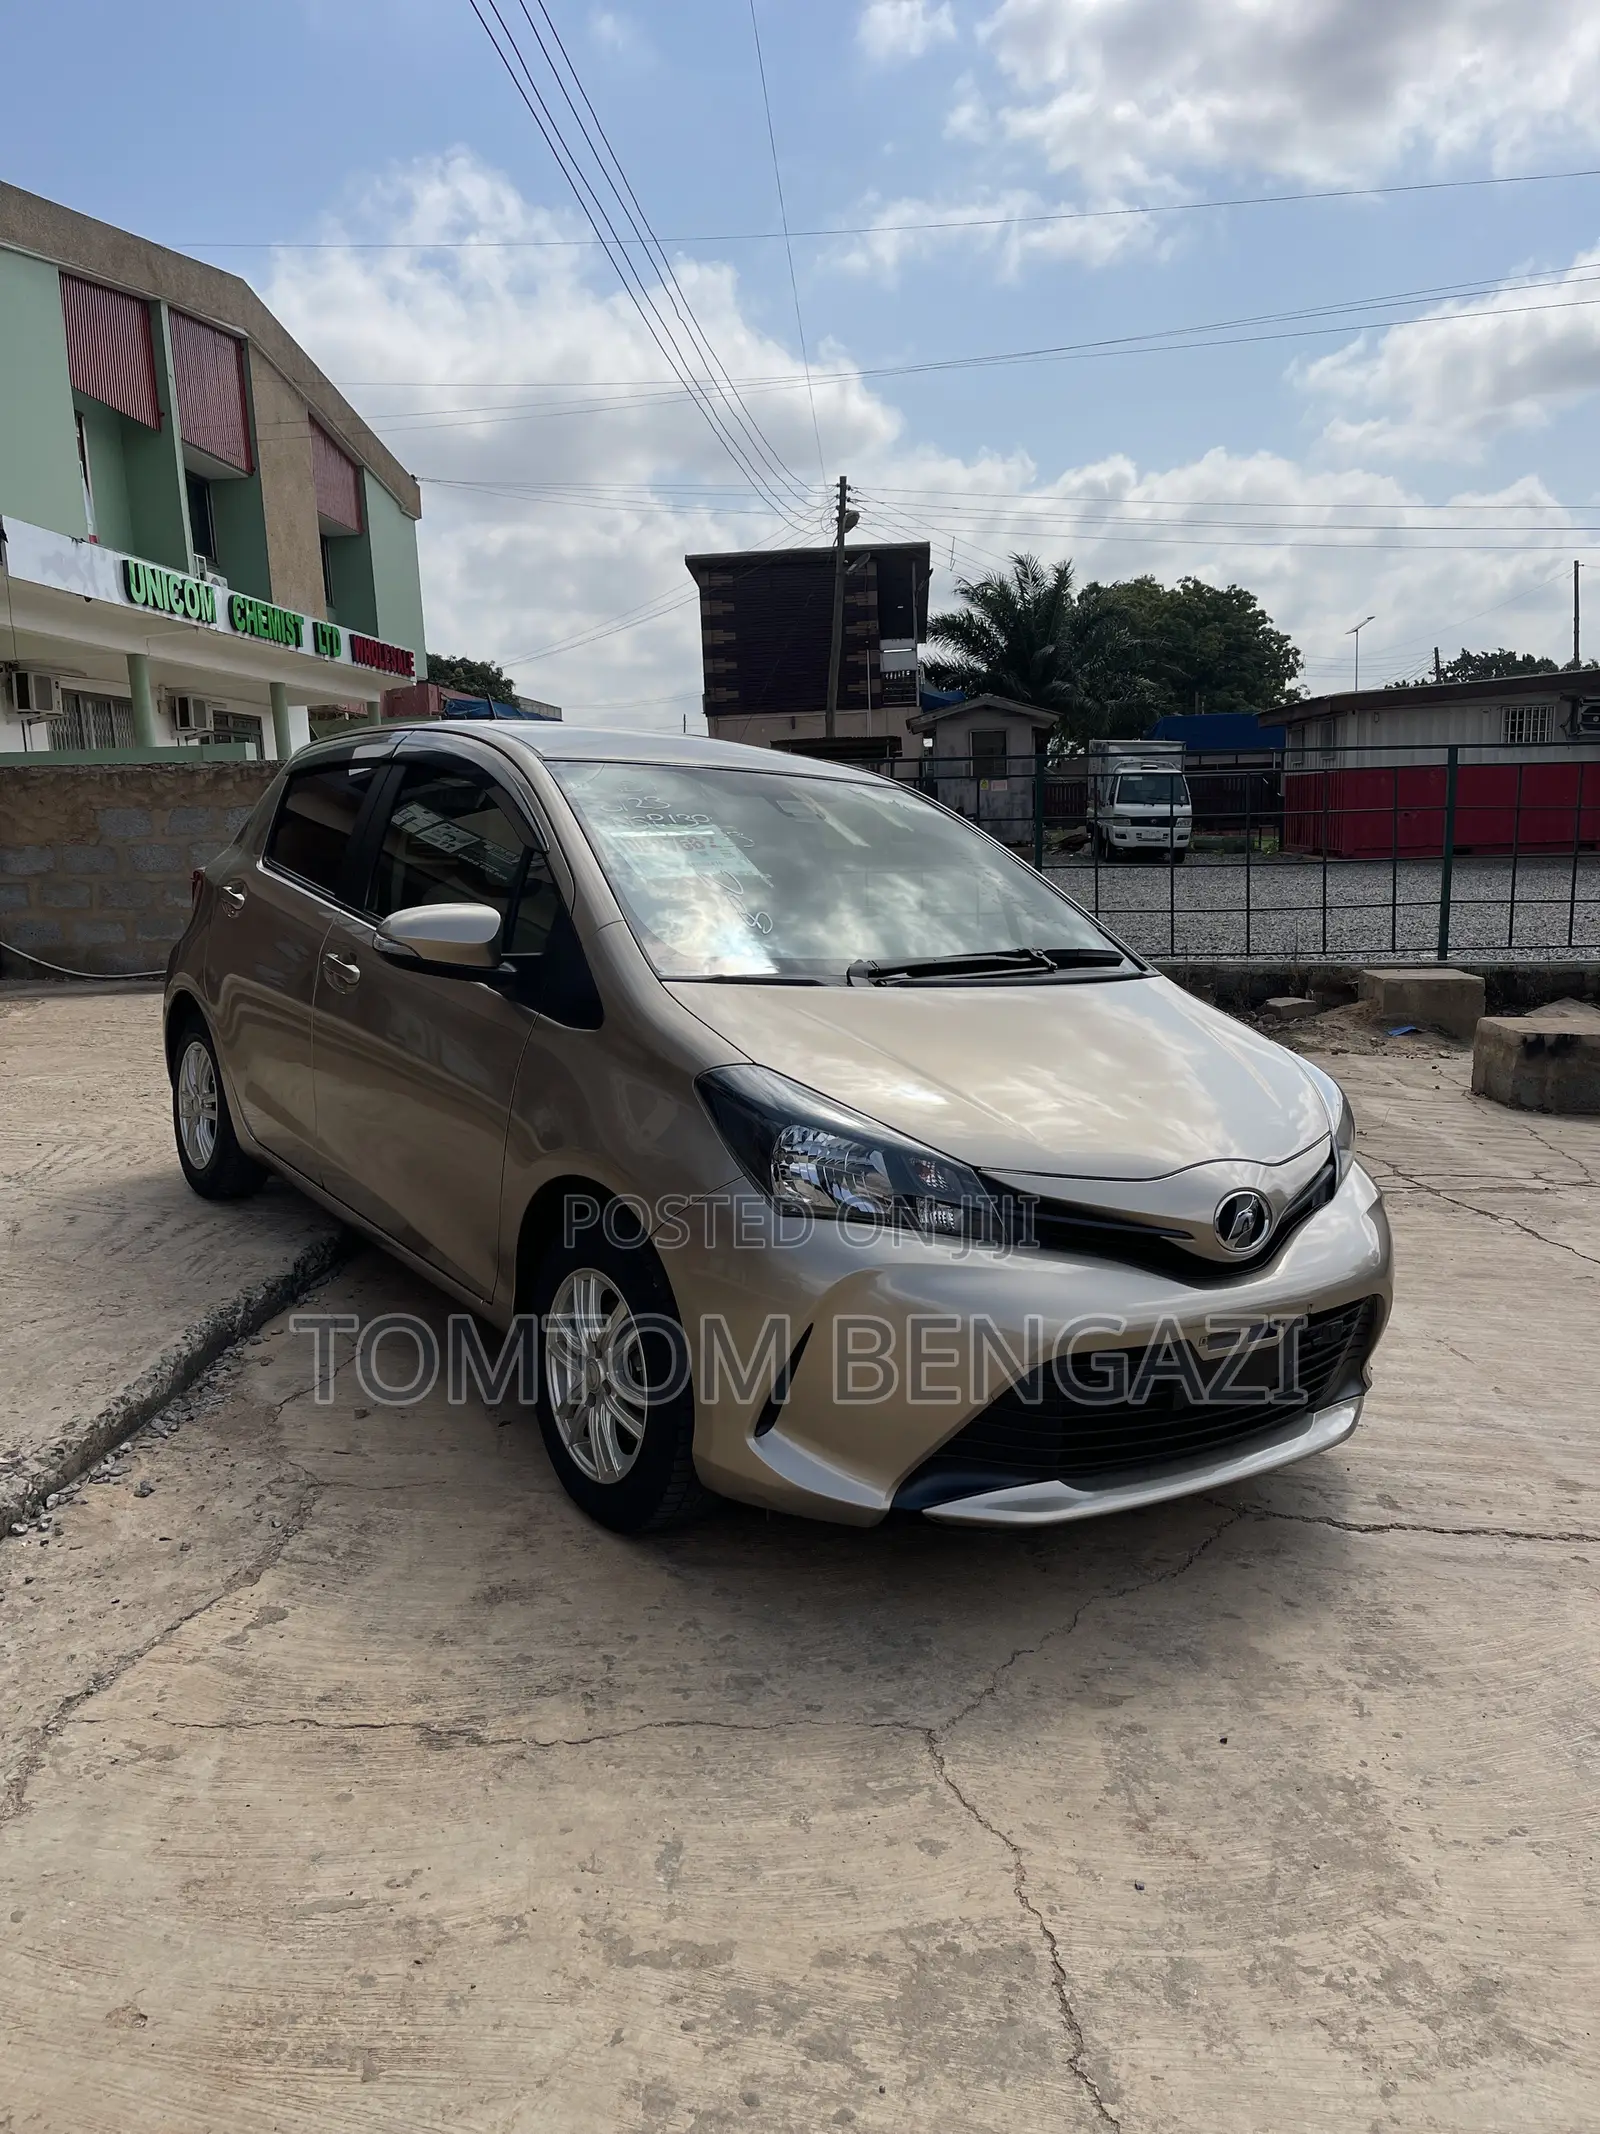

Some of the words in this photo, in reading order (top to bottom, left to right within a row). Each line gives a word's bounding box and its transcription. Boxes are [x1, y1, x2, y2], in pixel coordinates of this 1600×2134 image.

[122, 559, 217, 624] UNICOM
[228, 594, 305, 648] CHEMIST
[312, 621, 342, 658] LTD
[349, 634, 415, 677] WHOLESALE
